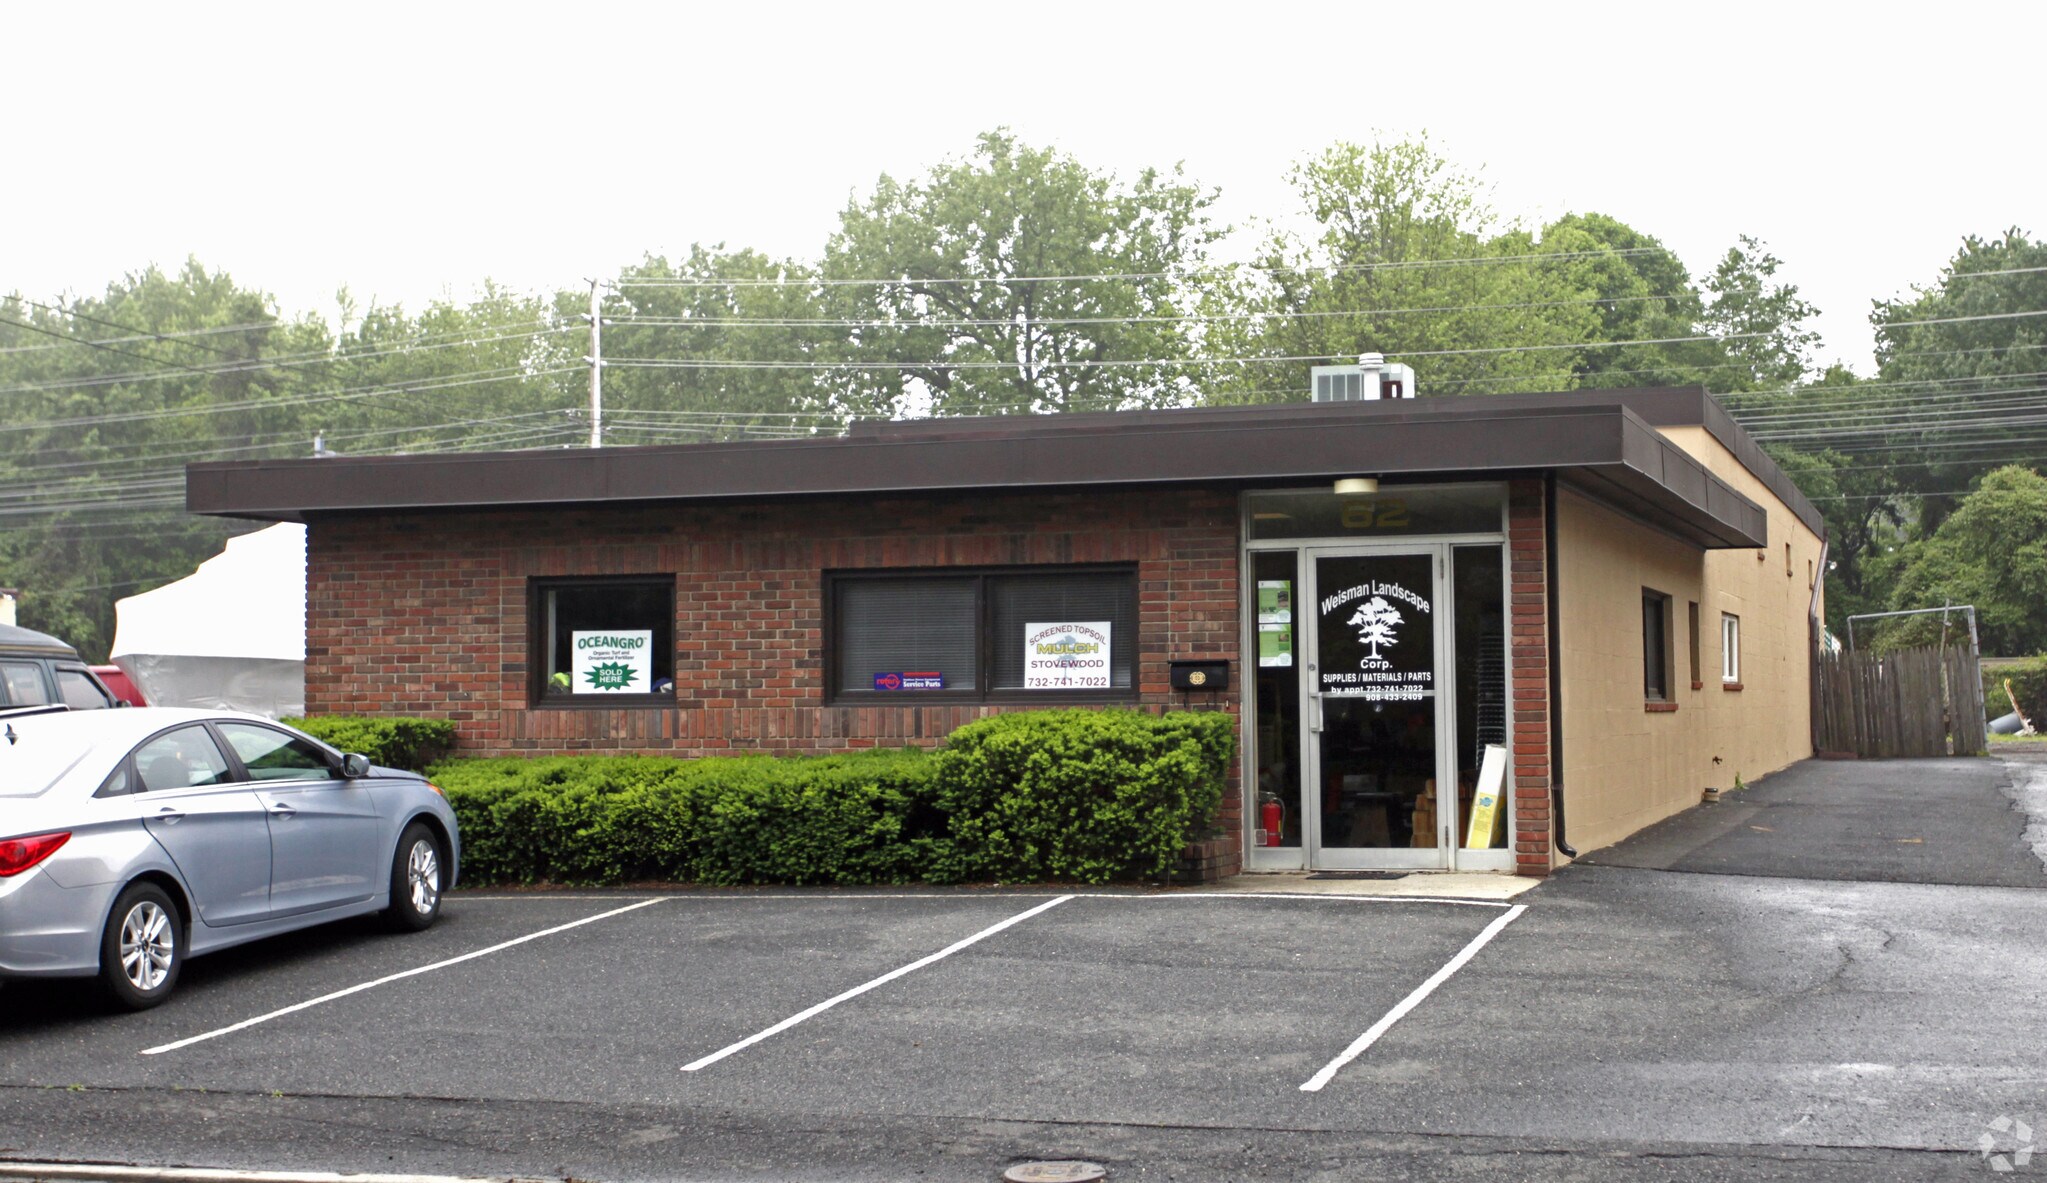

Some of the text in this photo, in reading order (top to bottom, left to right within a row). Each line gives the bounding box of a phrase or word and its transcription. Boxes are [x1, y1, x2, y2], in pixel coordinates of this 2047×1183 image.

[1342, 499, 1409, 528] 62
[1321, 579, 1430, 615] Weisman Landscape
[1029, 625, 1106, 646] SCREENED TOPSOIL
[578, 636, 644, 650] OCEANGRO
[1036, 643, 1099, 654] MULCH
[1031, 660, 1104, 668] STOVEWOOD
[1360, 659, 1393, 670] Corp.
[1028, 677, 1107, 687] 732-741-7022
[1323, 673, 1357, 683] SUPPLIES
[1362, 673, 1402, 682] MATERIALS
[1408, 671, 1432, 681] PARTS
[1331, 686, 1341, 694] by
[1365, 693, 1423, 701] 908-433-2409
